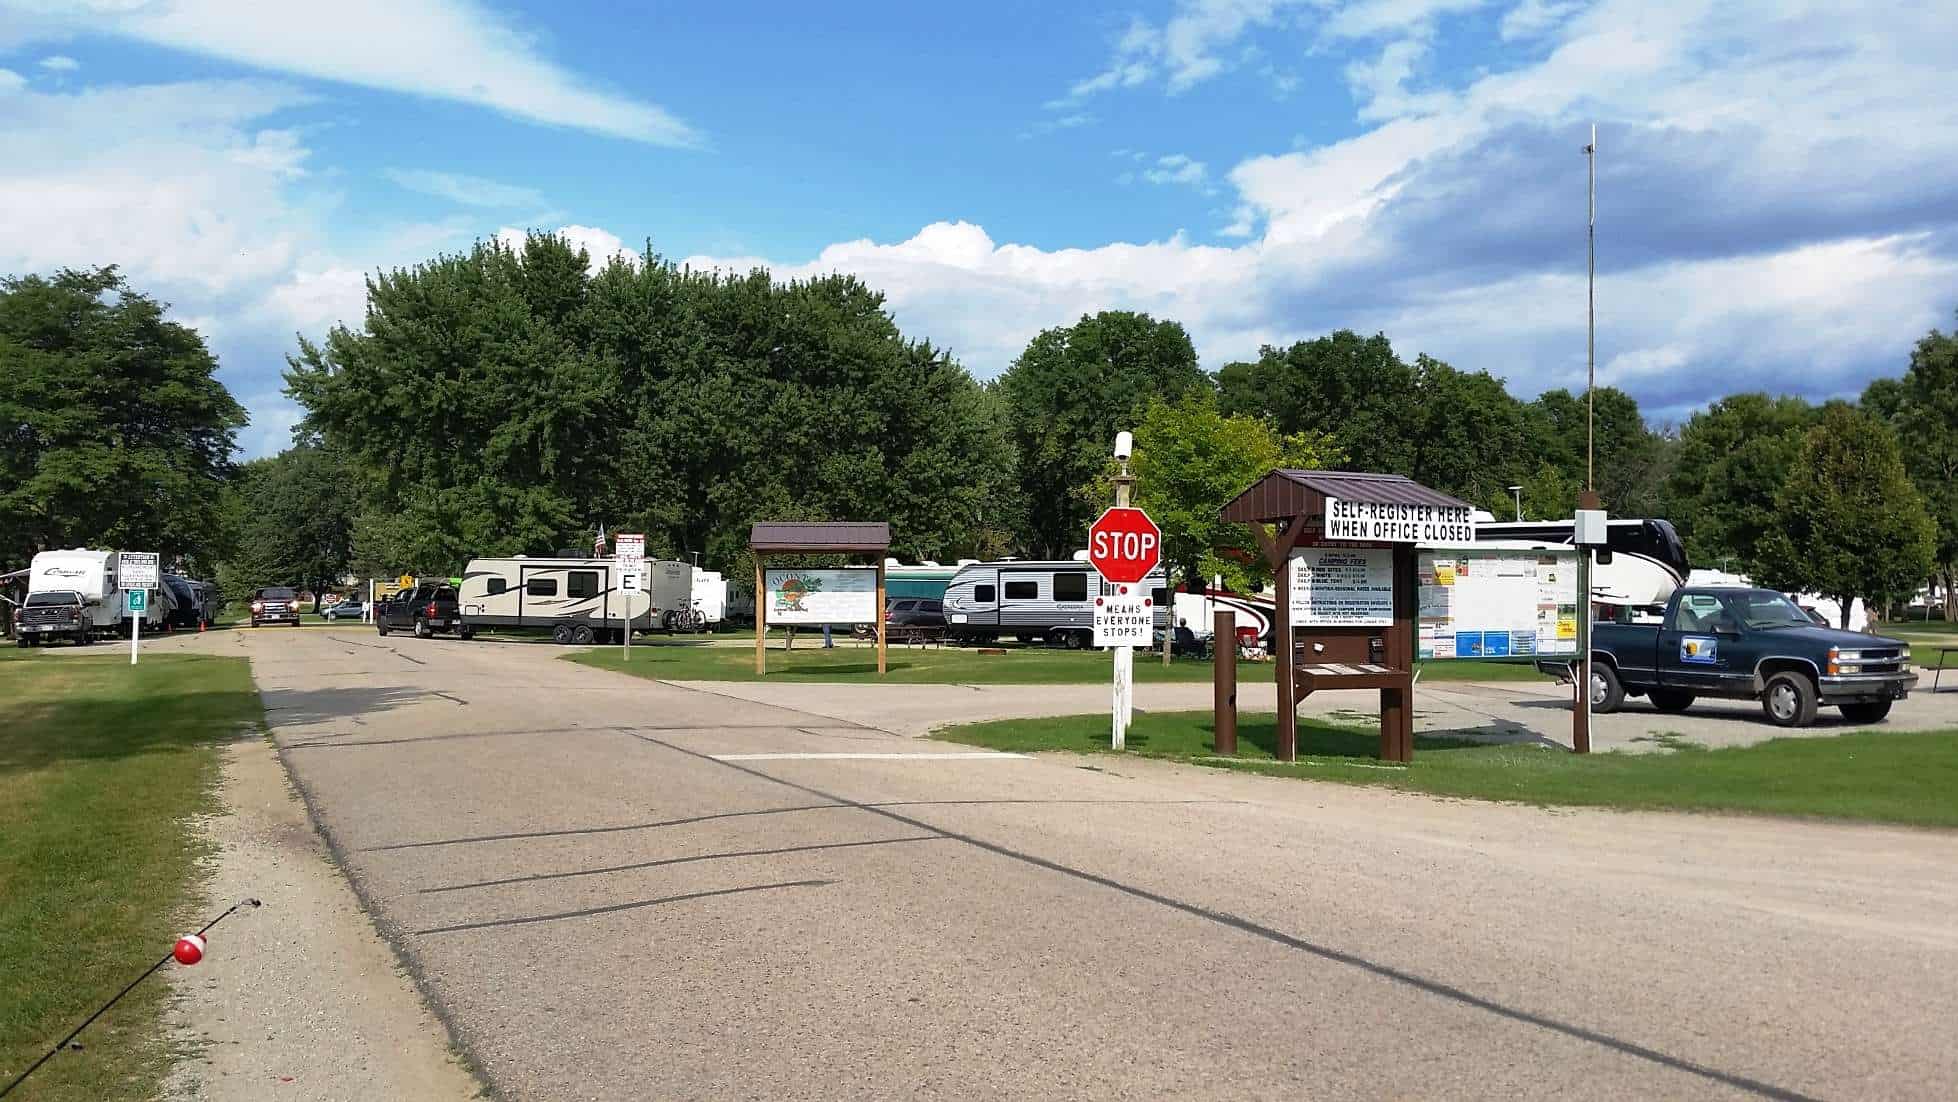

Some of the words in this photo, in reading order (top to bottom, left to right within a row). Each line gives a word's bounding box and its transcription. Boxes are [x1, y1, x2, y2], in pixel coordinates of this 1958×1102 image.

[1333, 501, 1433, 521] SELF-REGISTER
[1438, 506, 1470, 523] HERE
[1331, 520, 1368, 537] WHEN
[1374, 522, 1419, 539] OFFICE
[1424, 524, 1471, 541] CLOSED
[1094, 530, 1156, 561] STOP
[622, 574, 636, 590] E
[1106, 604, 1142, 614] MEANS
[1096, 616, 1152, 625] EVERYONE
[1103, 627, 1143, 637] STOPS!
